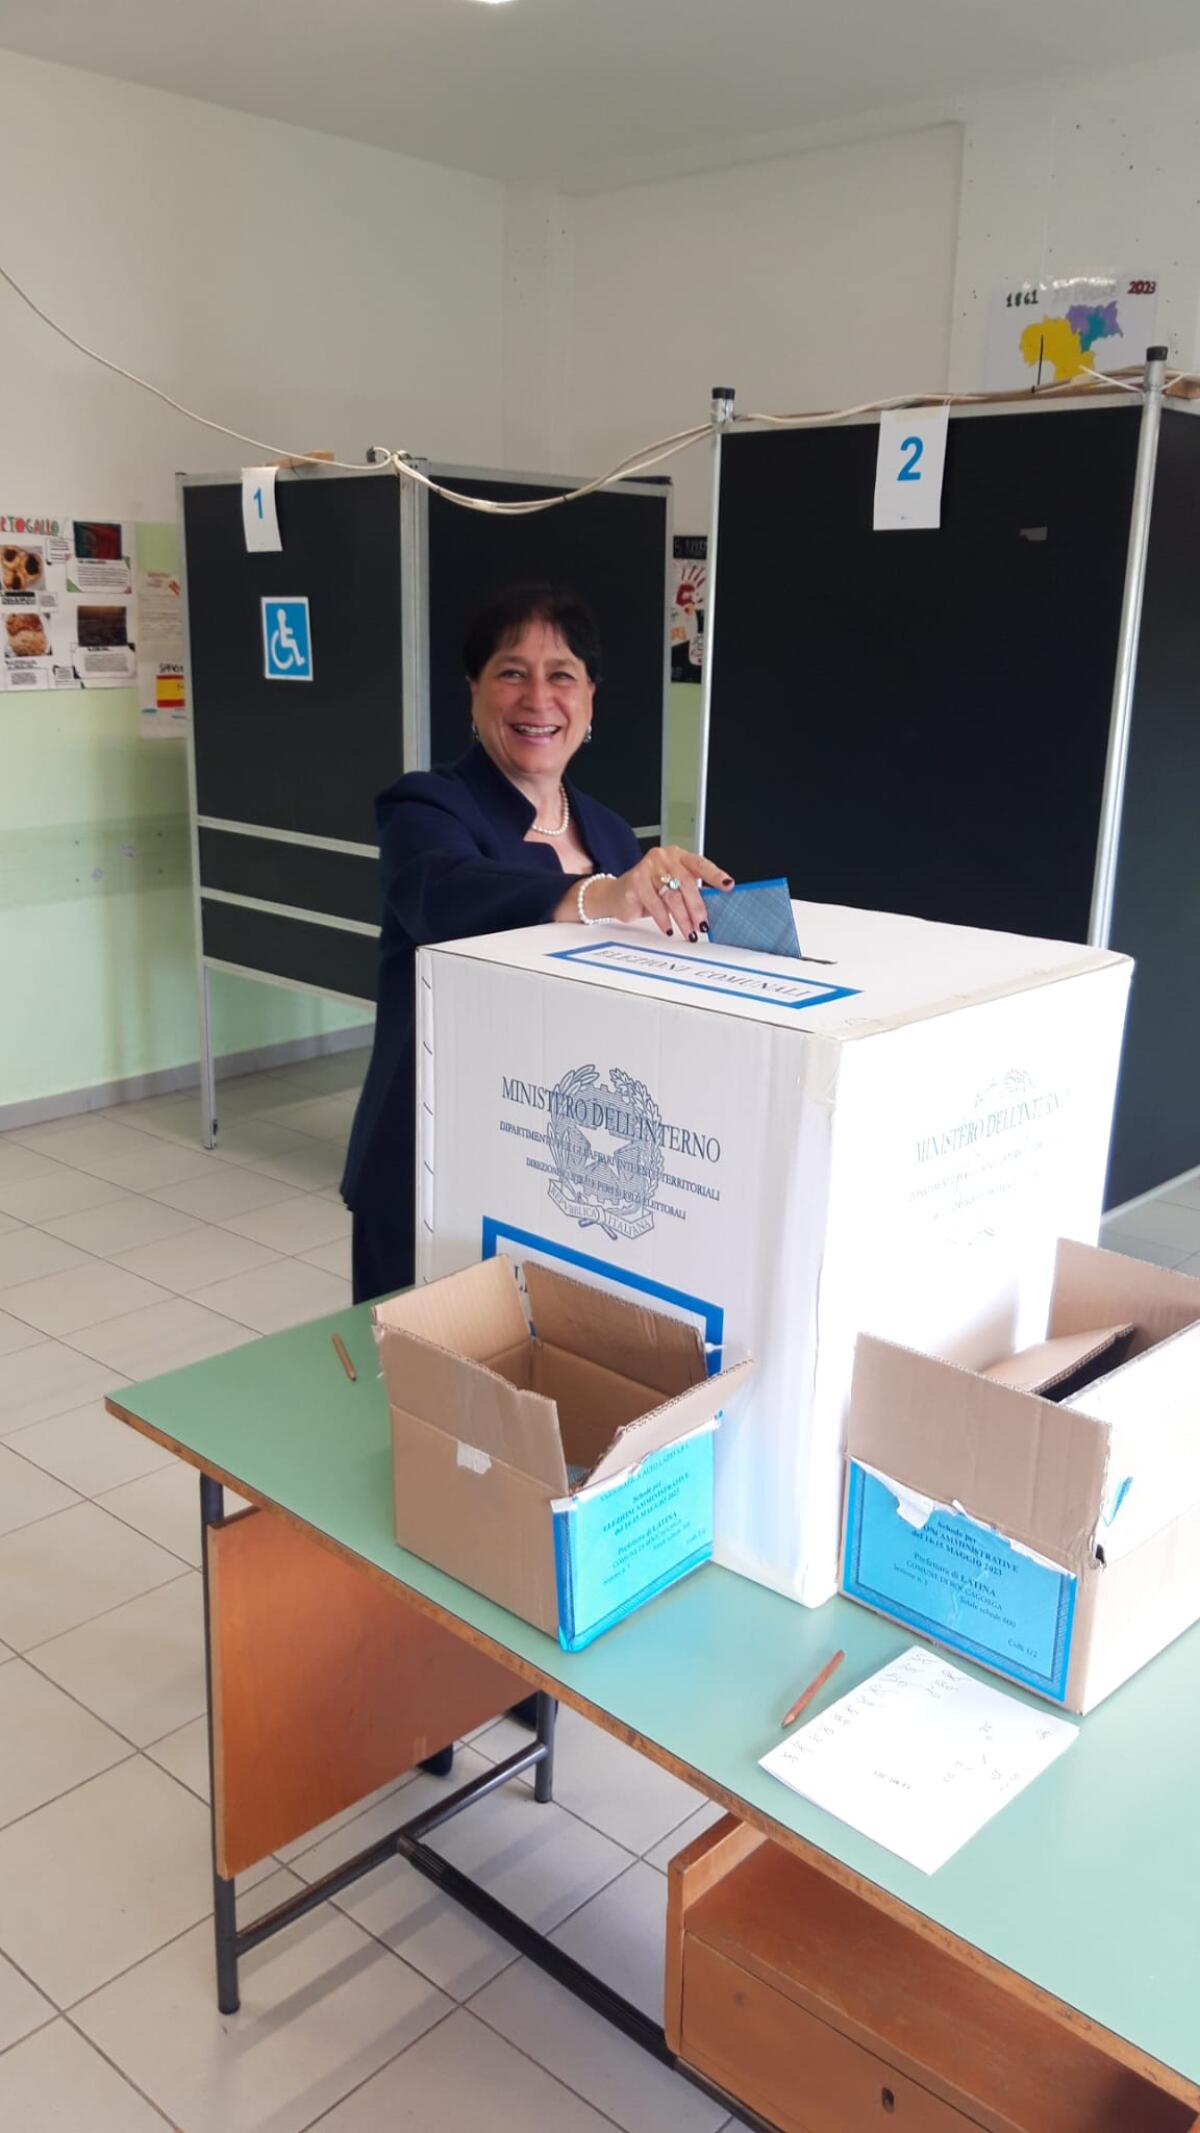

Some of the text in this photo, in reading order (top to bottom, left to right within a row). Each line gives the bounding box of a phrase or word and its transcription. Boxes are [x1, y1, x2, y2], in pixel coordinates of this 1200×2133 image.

[1006, 290, 1039, 308] 1861
[1127, 280, 1156, 295] 2023
[897, 436, 924, 482] 2
[253, 487, 264, 519] 1
[592, 949, 813, 998] ELEZIONI COMUNALI
[502, 1076, 721, 1164] MINISTERO DELL'INTERNO
[661, 1172, 720, 1201] TERRITORIALI
[941, 1533, 1018, 1573] AMMINISTRATIVE
[946, 1543, 982, 1567] MAGGIO
[984, 1562, 1002, 1577] 2023
[960, 1574, 996, 1597] LATINA
